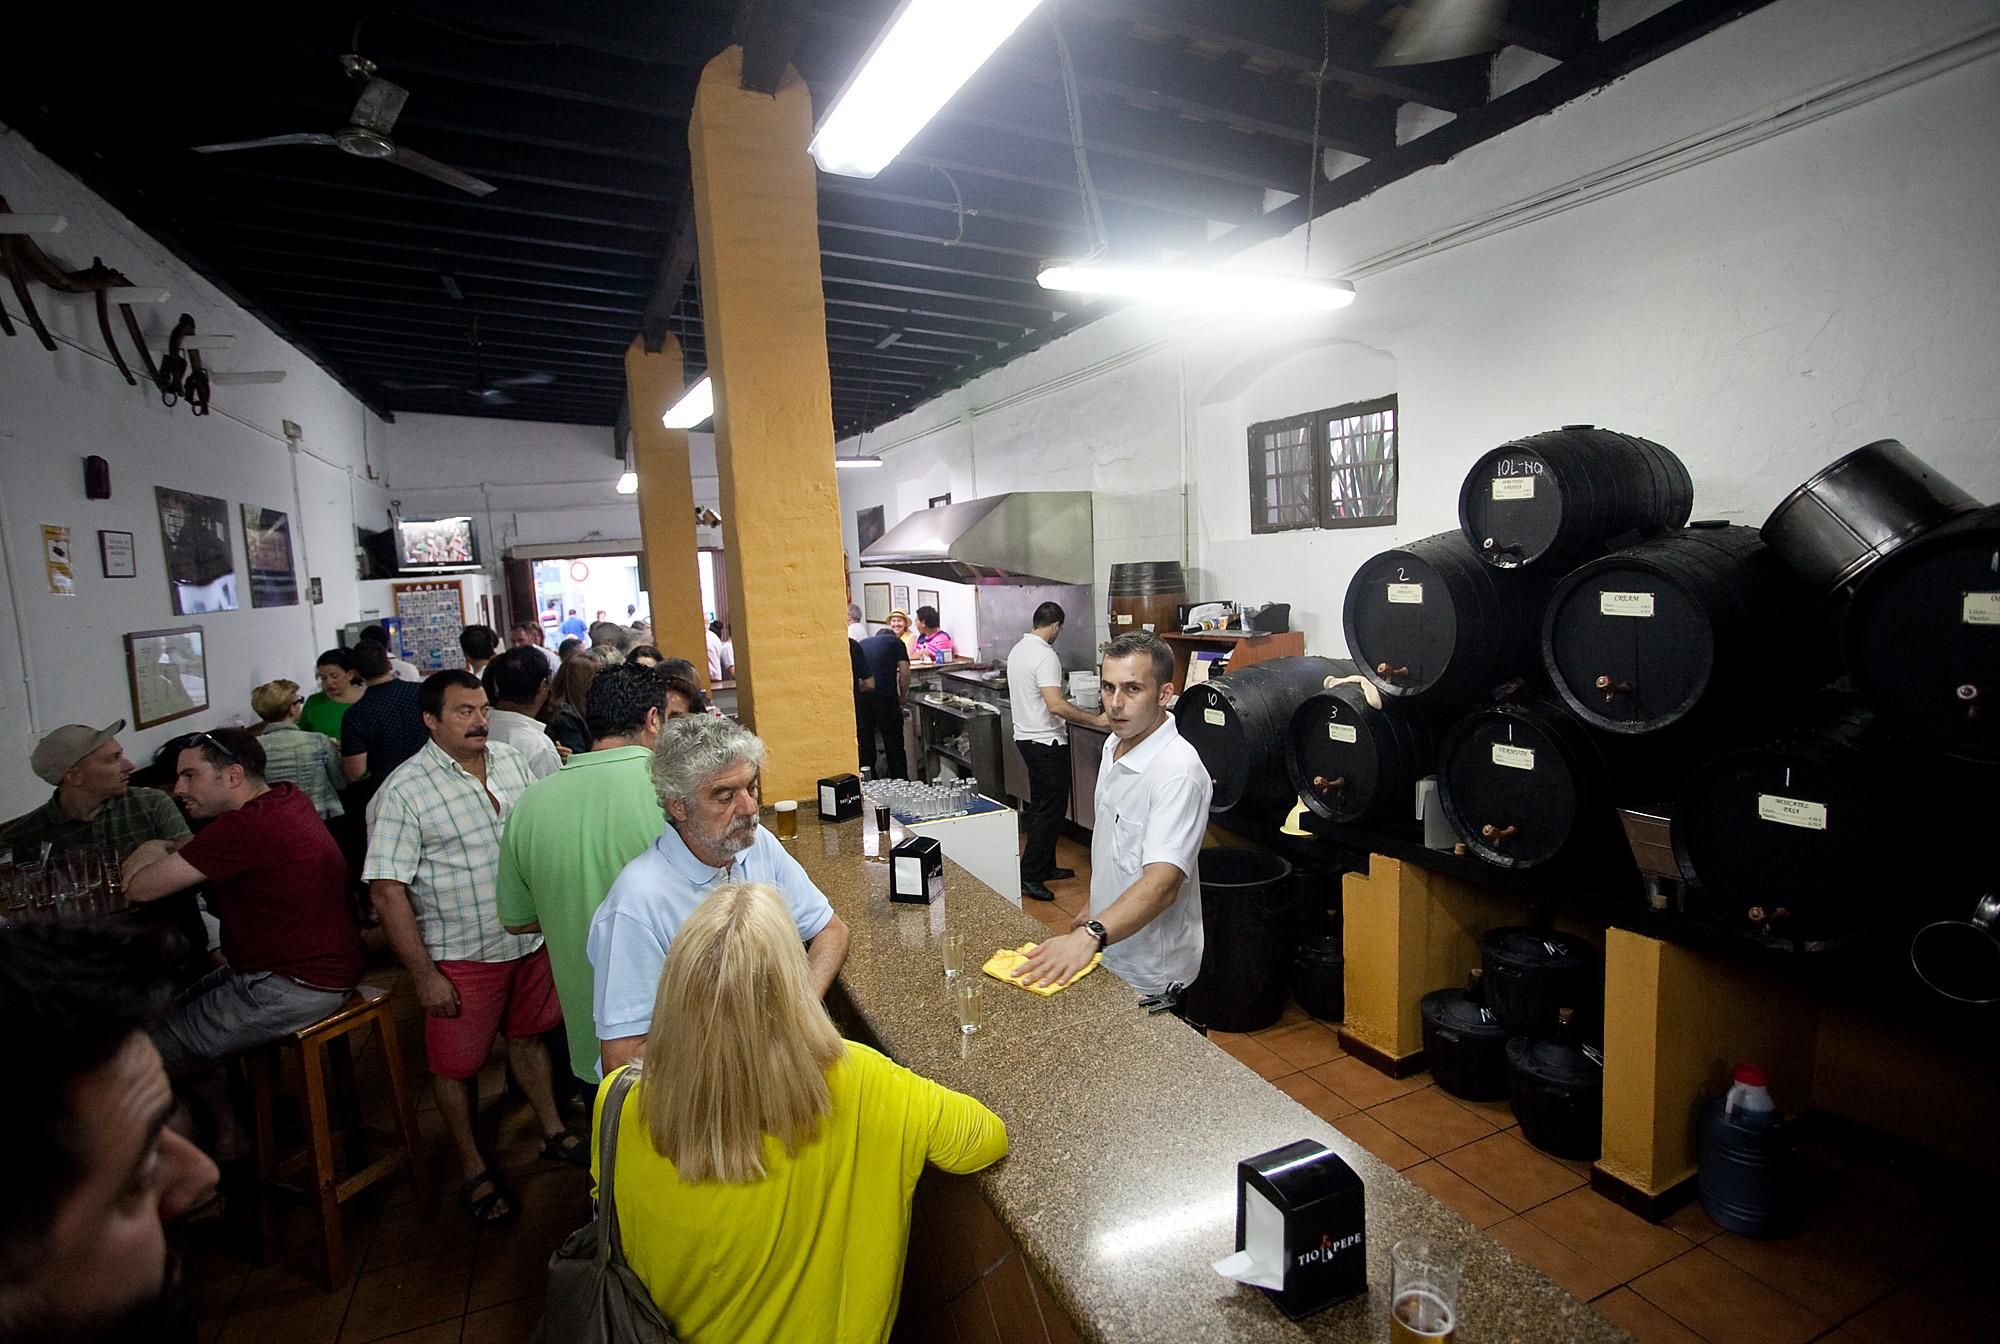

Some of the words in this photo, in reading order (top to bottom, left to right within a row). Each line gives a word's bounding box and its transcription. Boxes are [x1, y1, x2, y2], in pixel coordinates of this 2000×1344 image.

[1397, 567, 1410, 581] 2
[1207, 692, 1218, 706] 10
[1330, 705, 1338, 719] 3
[1776, 798, 1810, 809] MOSCATEL
[1298, 1250, 1320, 1266] TIO
[1333, 1232, 1361, 1252] PEPE
